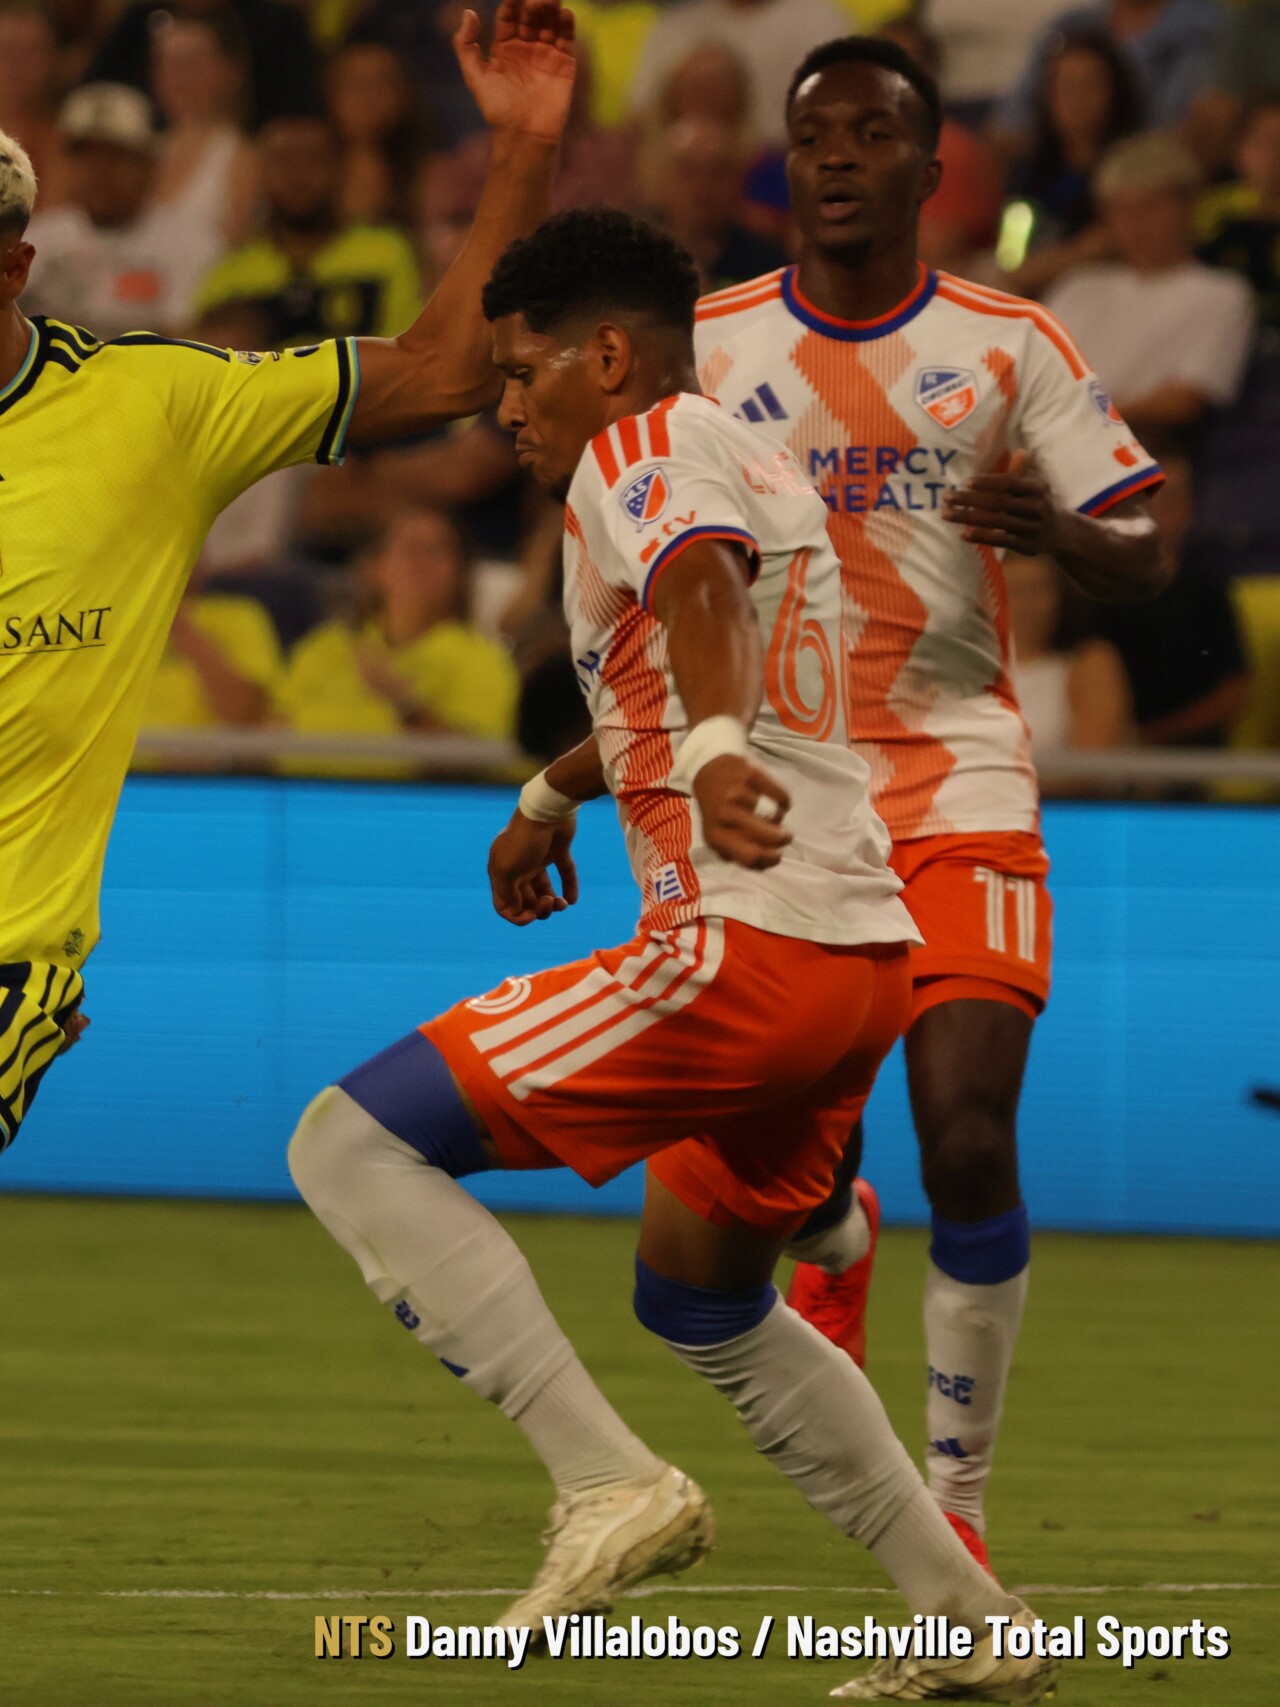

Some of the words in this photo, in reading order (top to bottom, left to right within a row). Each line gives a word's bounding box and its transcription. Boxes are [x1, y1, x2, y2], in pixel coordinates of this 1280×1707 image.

[808, 446, 958, 477] MERCY
[814, 482, 957, 513] HEALT
[973, 866, 1036, 963] 11
